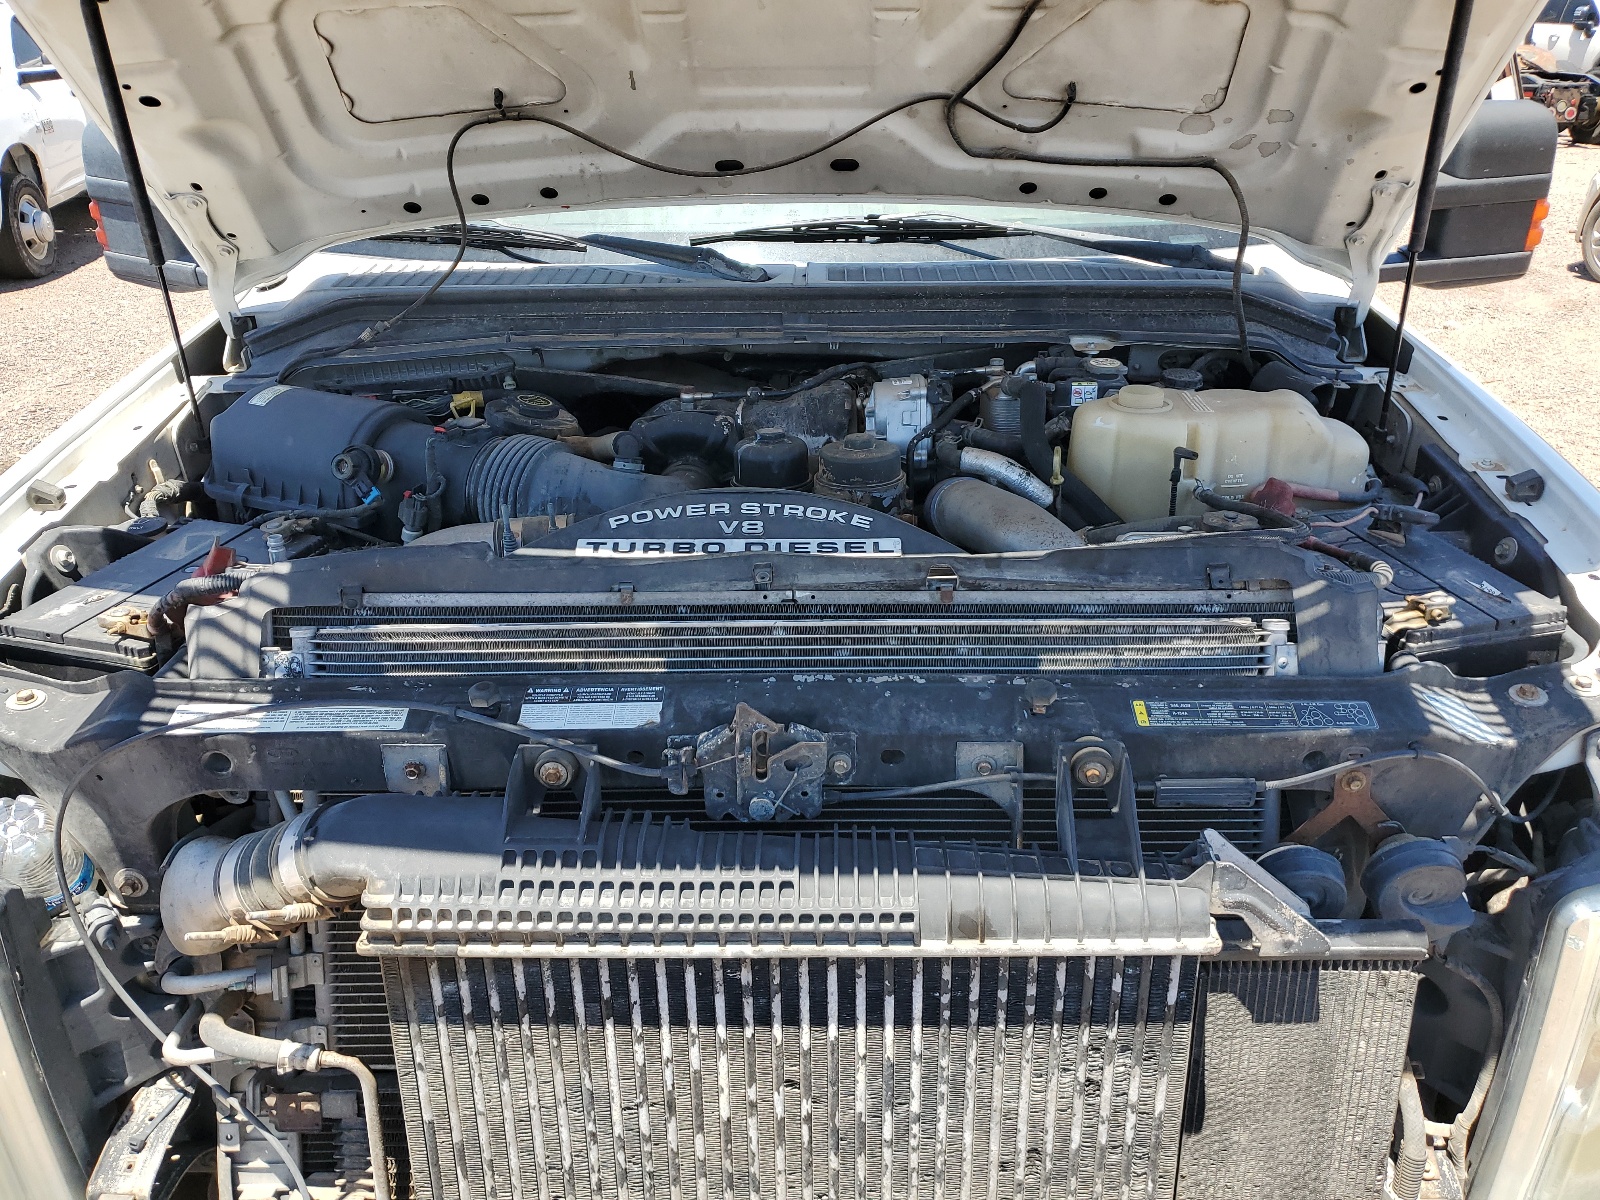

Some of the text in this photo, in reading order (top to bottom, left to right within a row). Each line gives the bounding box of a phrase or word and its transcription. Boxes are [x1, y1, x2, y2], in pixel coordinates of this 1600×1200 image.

[608, 502, 874, 531] POWER STROKE
[718, 520, 764, 535] V8
[585, 541, 895, 555] TURBO DIESEL
